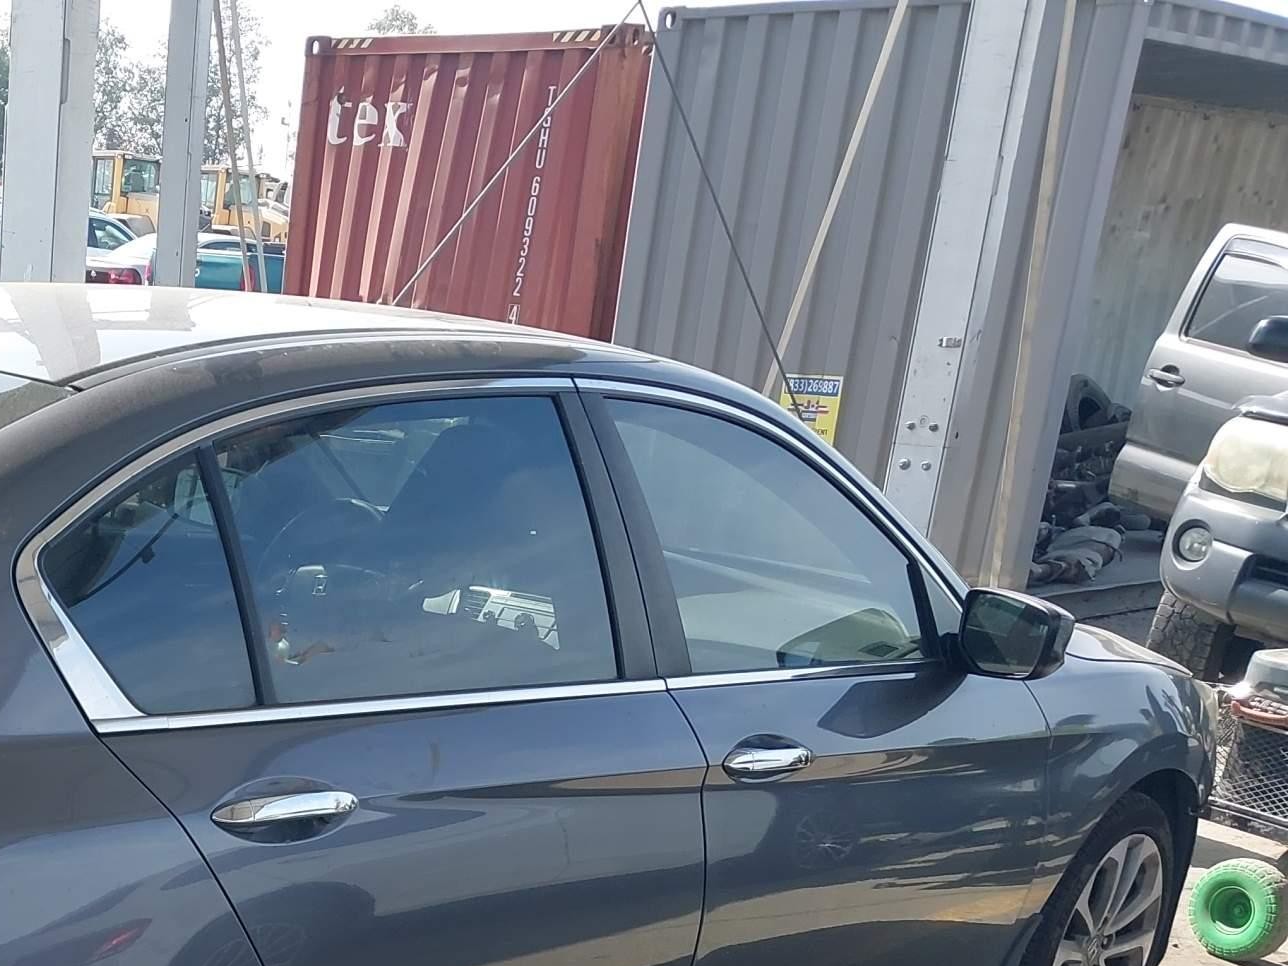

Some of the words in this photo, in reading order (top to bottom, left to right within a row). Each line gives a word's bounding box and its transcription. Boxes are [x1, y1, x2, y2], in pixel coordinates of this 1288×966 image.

[327, 86, 413, 147] tex
[513, 177, 540, 296] 609322
[508, 304, 520, 324] 4
